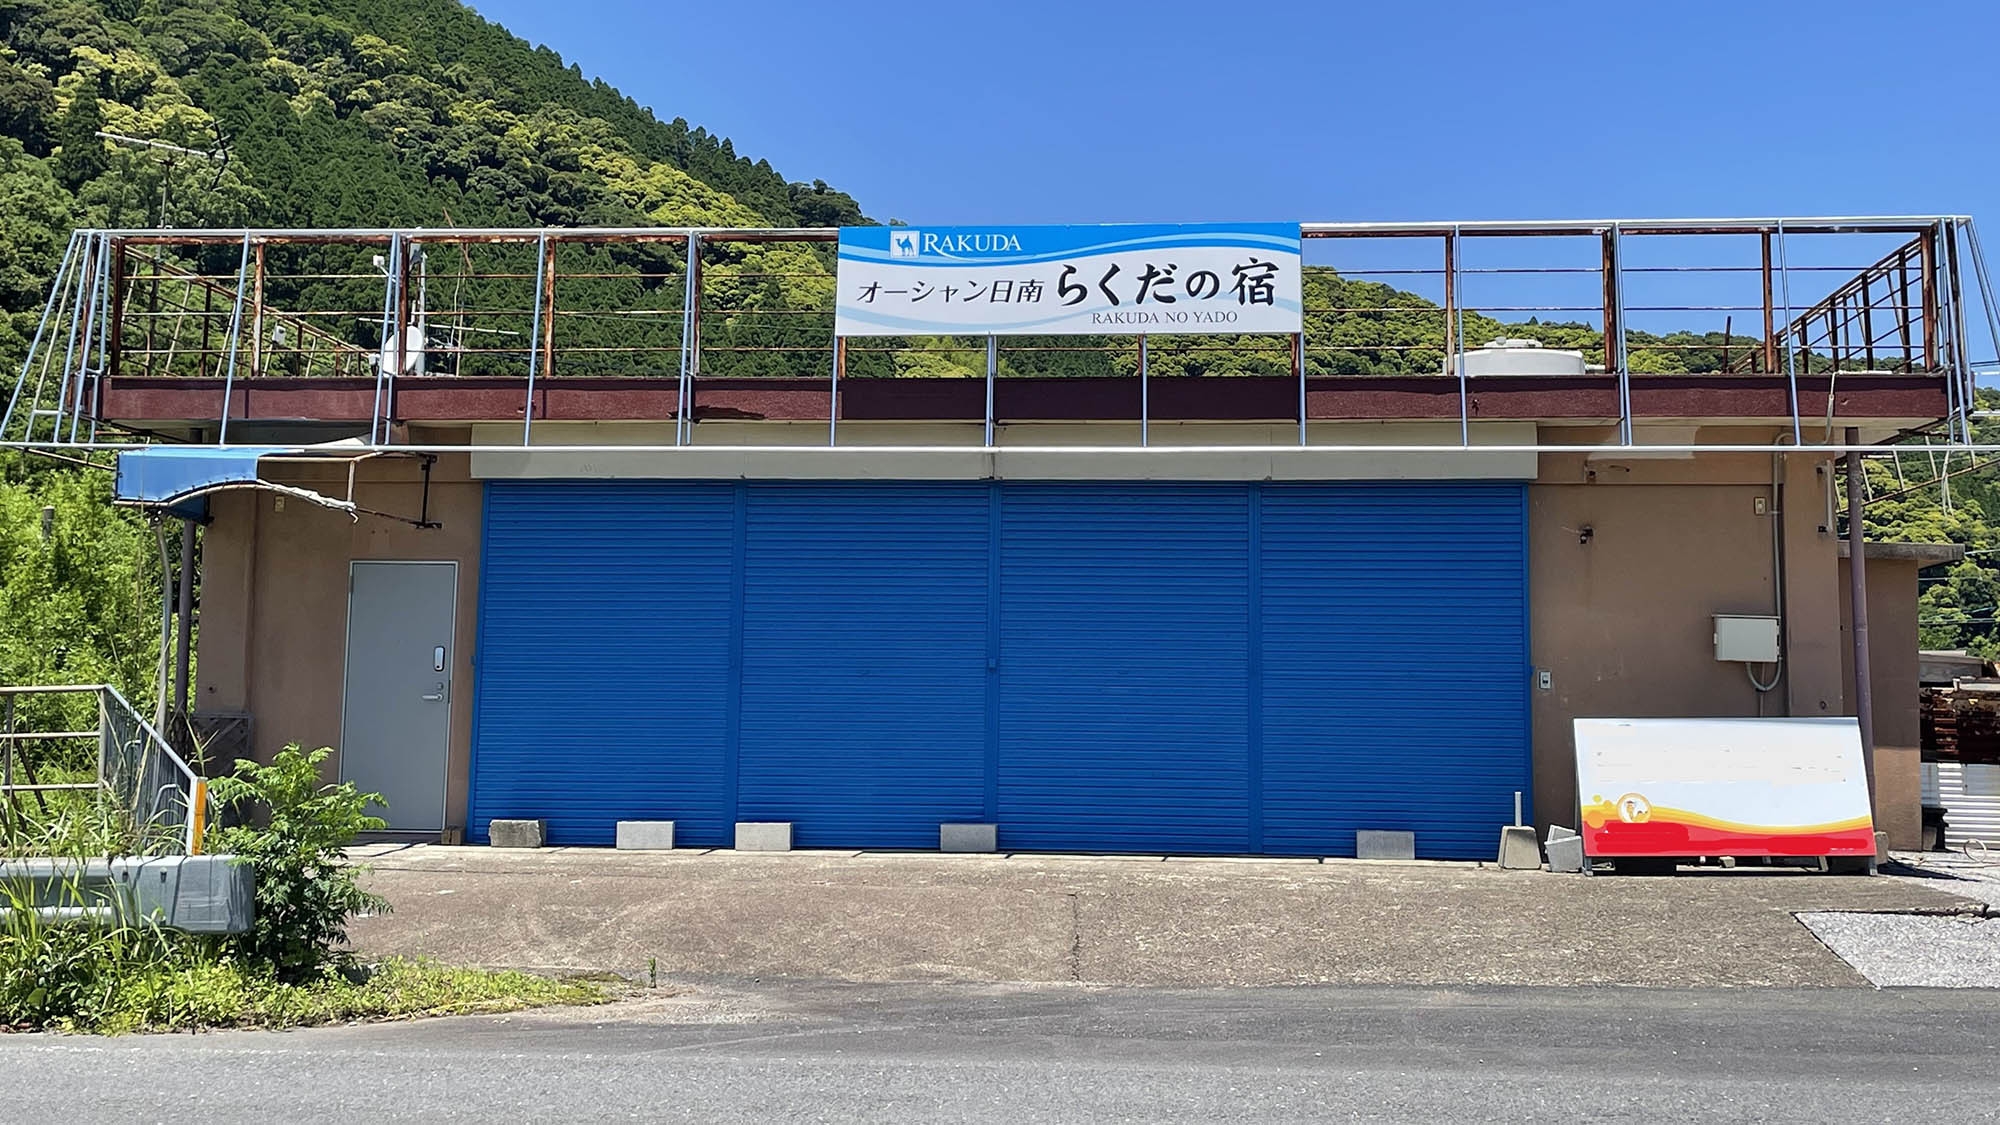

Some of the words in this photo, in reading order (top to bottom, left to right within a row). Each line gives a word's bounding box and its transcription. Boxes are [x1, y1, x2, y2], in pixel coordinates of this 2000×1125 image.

[923, 233, 1022, 254] RAKUDA
[856, 279, 1044, 304] オーシャン日南
[1058, 257, 1278, 306] らくだの宿
[1092, 312, 1160, 324] RAKUDA
[1165, 311, 1188, 324] NO
[1193, 310, 1237, 324] YADO
